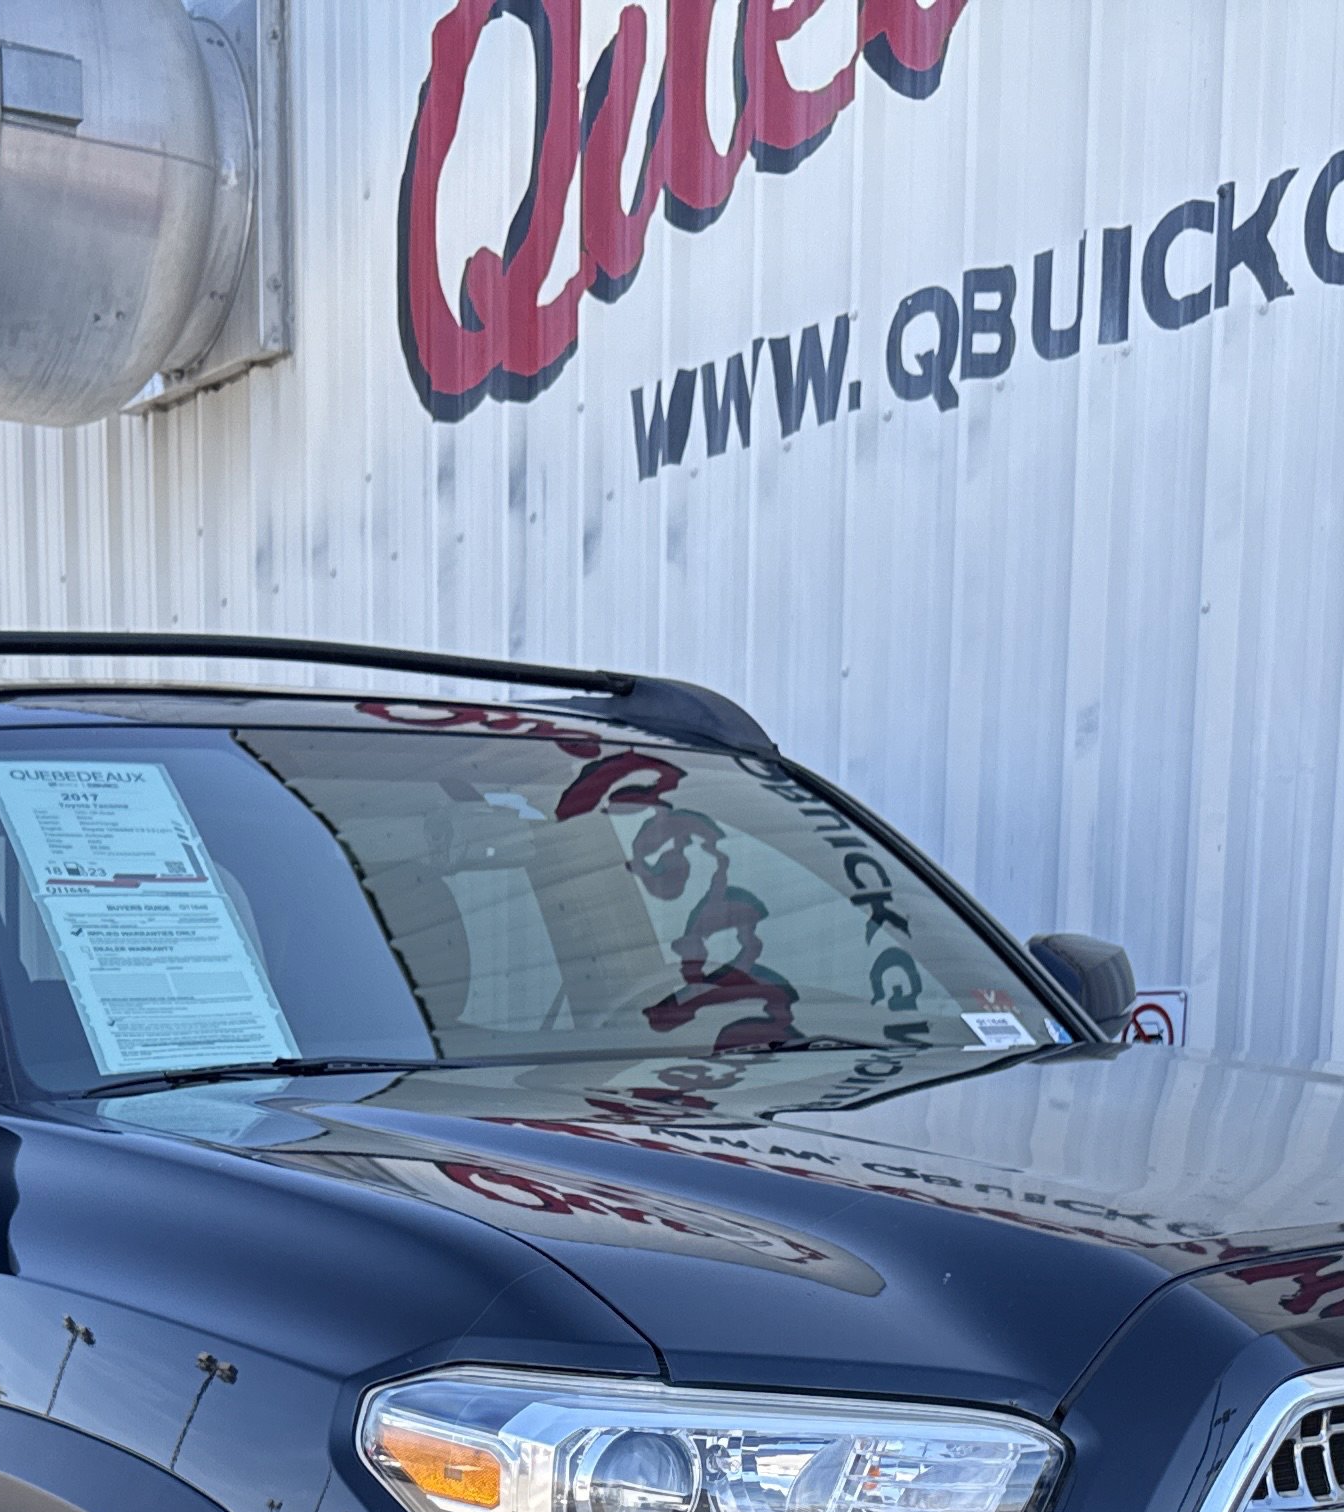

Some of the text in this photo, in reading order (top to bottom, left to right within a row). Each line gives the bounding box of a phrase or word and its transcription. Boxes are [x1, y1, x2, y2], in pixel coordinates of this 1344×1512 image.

[398, 0, 965, 423] Que
[9, 769, 147, 783] QUEBEDEAUX
[60, 792, 99, 802] 2017
